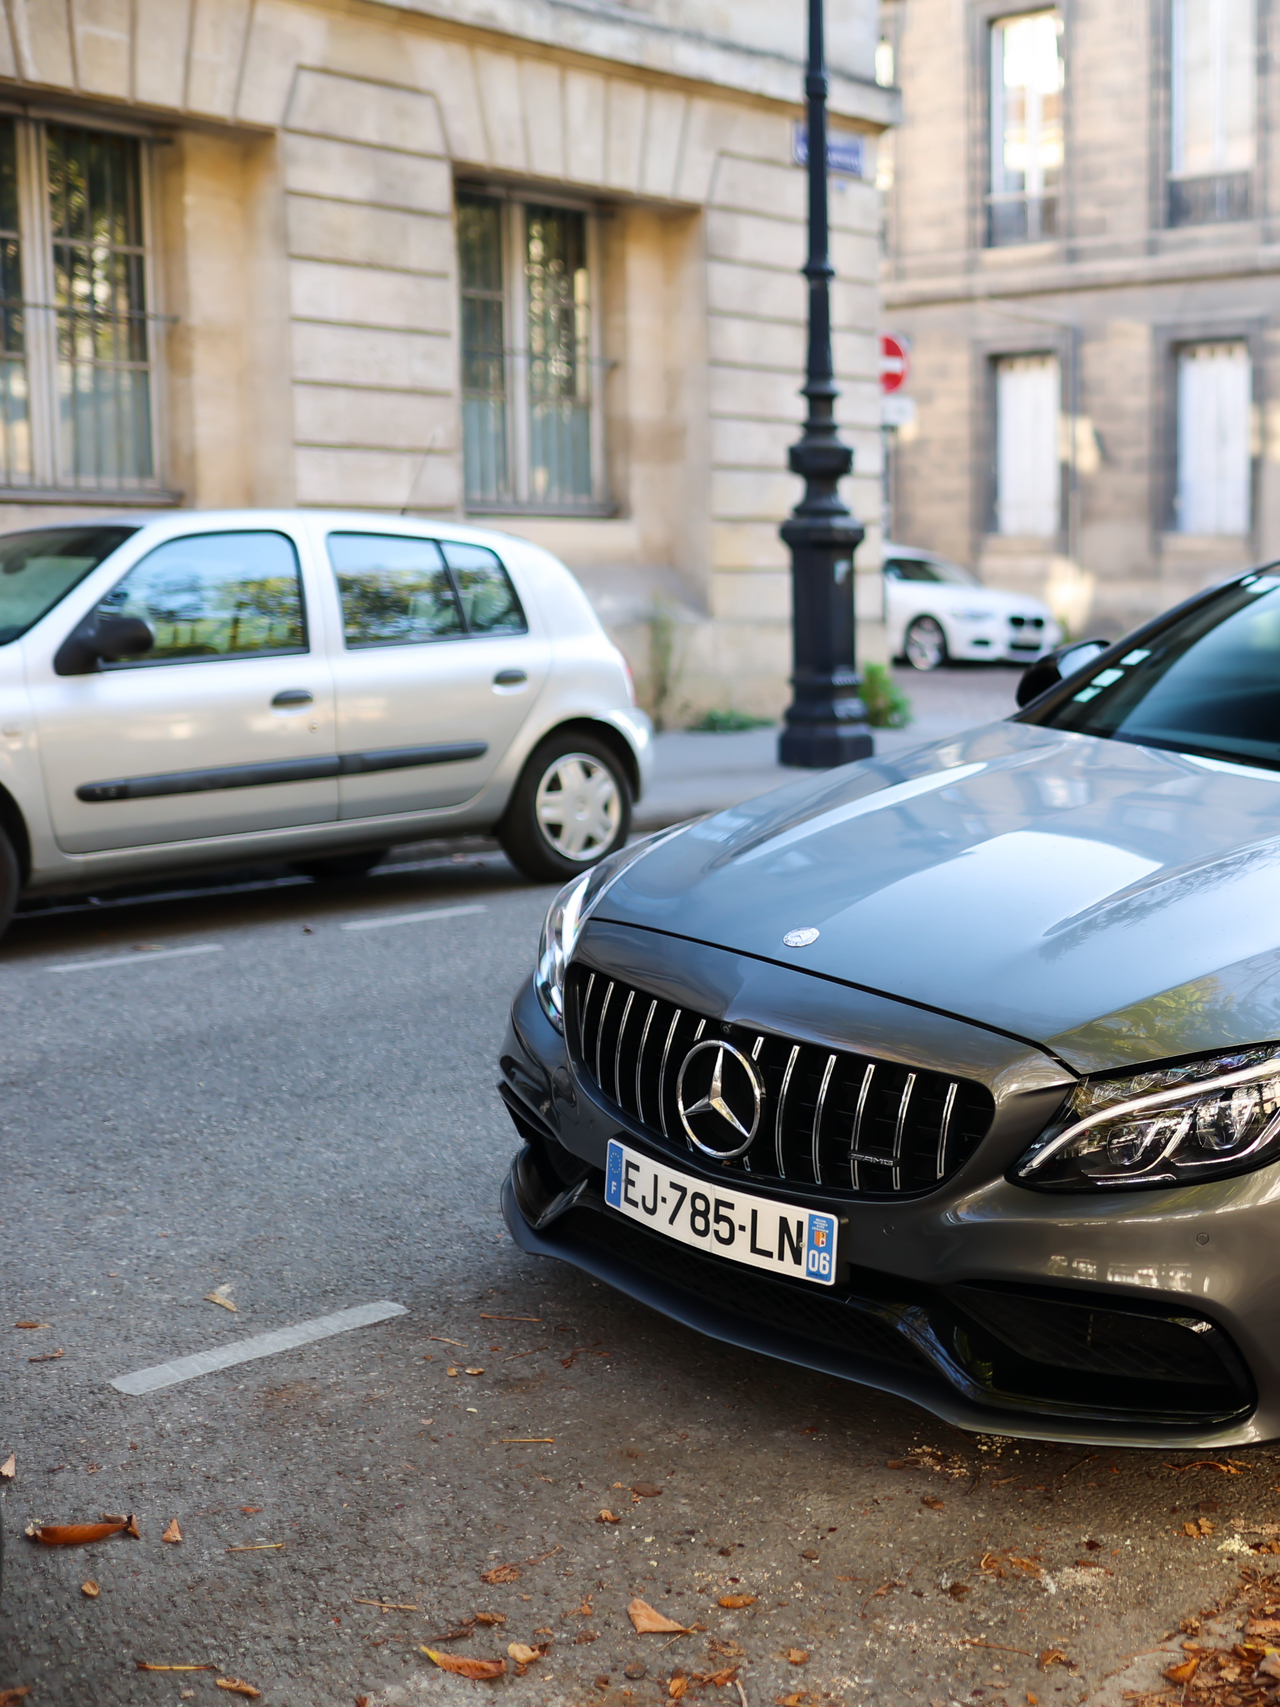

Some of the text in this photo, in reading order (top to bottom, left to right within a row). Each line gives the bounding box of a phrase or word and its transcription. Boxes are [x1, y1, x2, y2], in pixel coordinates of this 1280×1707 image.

[863, 1155, 894, 1167] AMG
[611, 1181, 617, 1194] F
[623, 1159, 804, 1266] EJ-785-LN
[808, 1249, 830, 1275] 06
